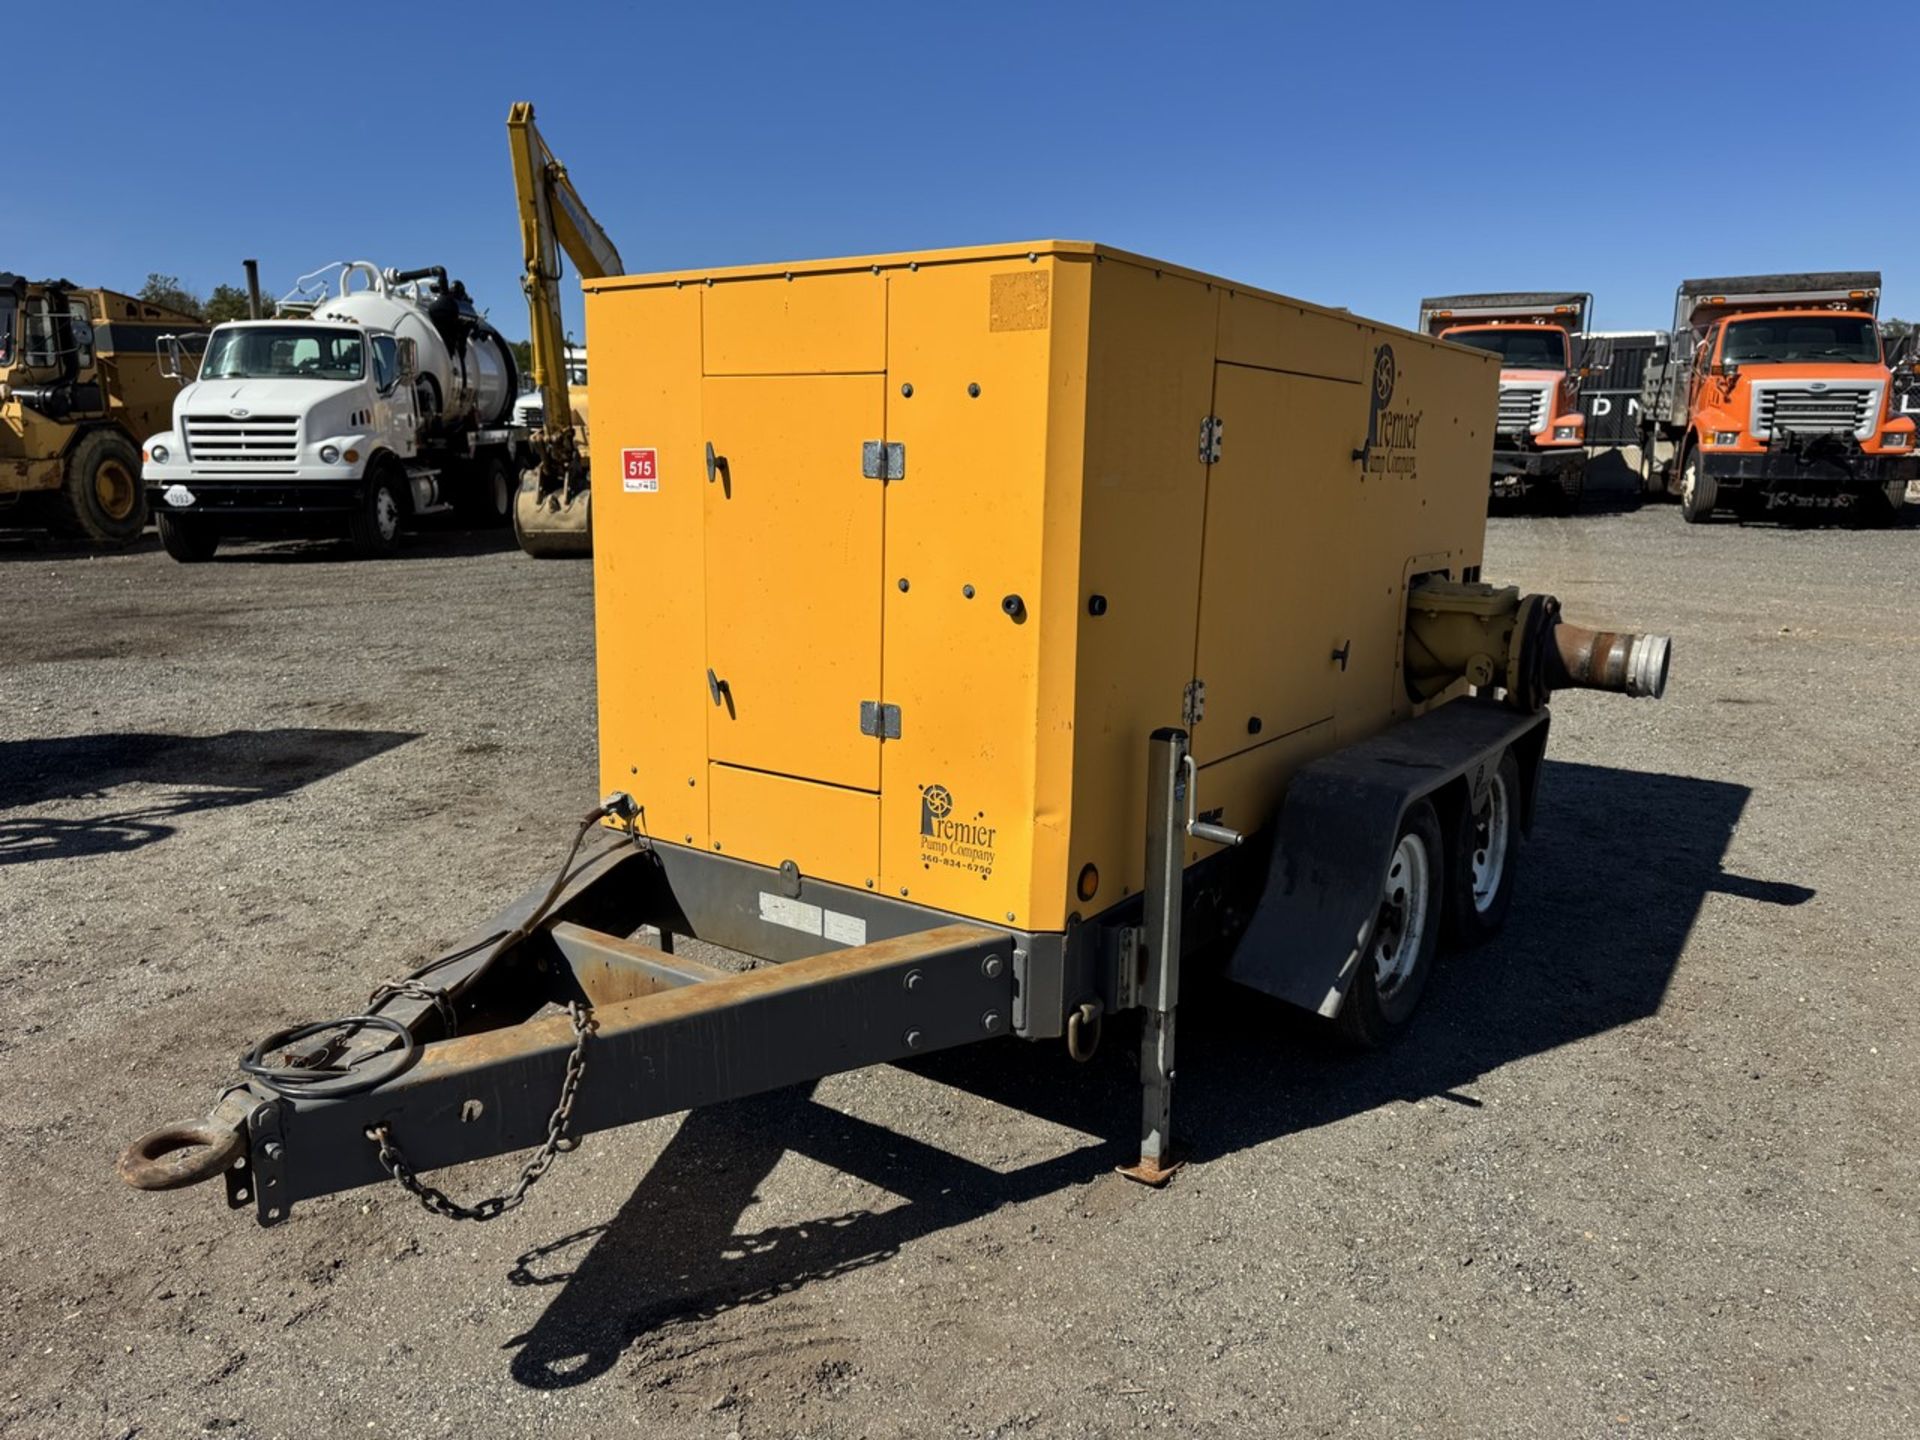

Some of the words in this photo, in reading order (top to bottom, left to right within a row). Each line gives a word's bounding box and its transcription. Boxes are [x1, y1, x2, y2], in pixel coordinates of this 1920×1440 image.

[1368, 344, 1420, 449] Premier
[629, 460, 651, 476] 515
[920, 784, 996, 848] Premier
[921, 836, 947, 856] Pump
[949, 841, 995, 866] Company
